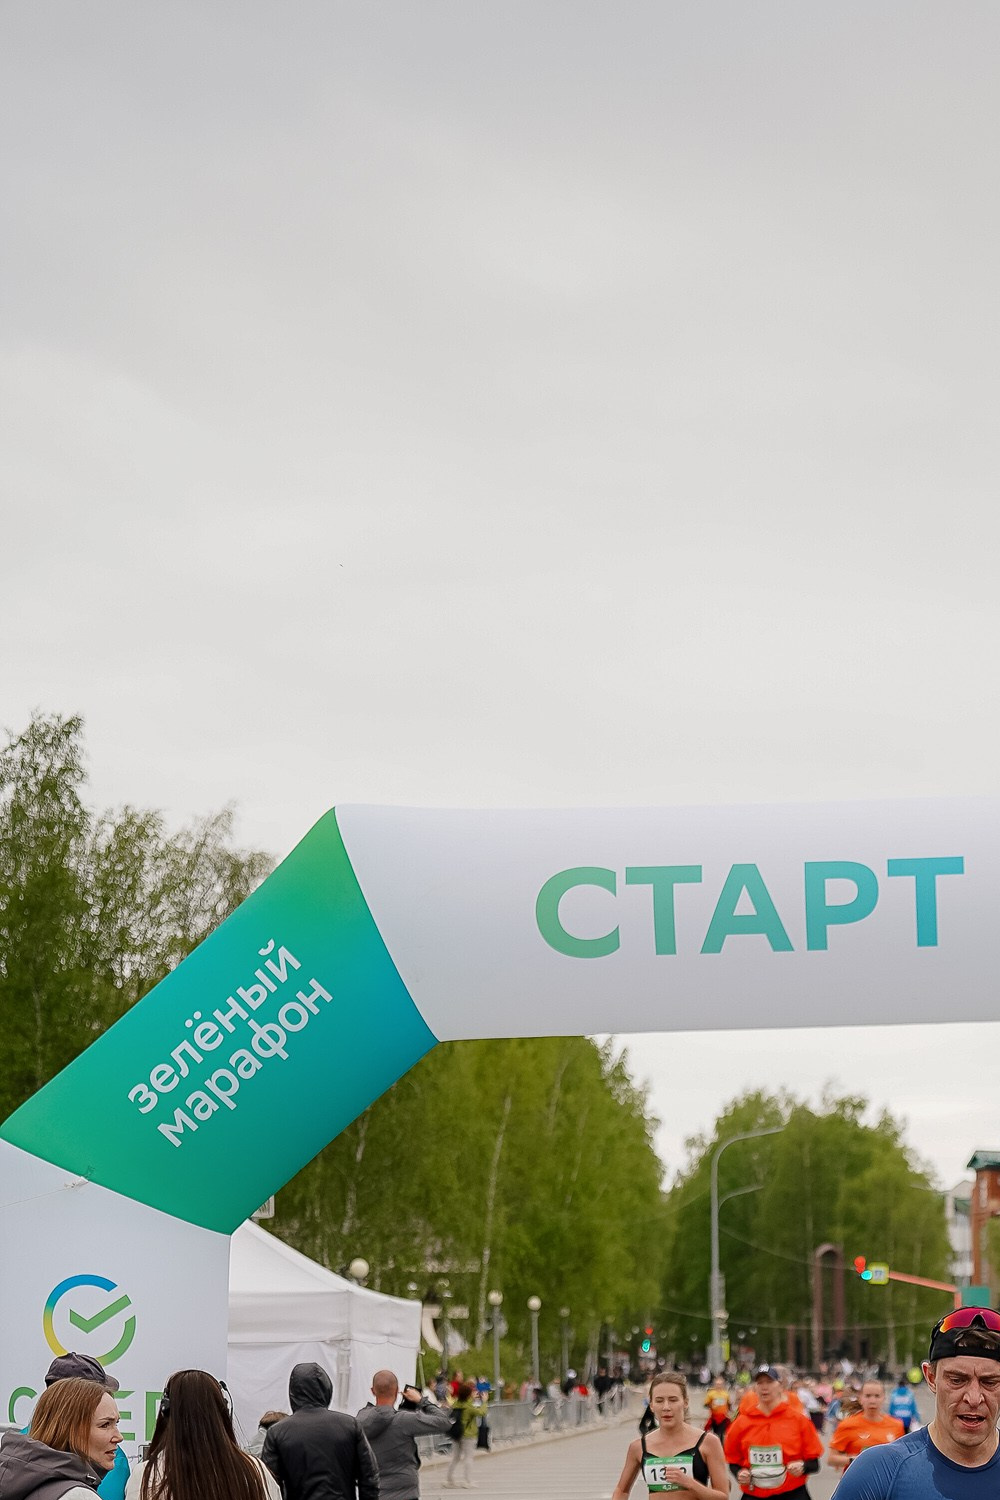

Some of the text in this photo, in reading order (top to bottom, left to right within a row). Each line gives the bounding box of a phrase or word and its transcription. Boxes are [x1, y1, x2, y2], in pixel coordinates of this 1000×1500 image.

[535, 856, 965, 959] СТАРТ
[127, 938, 302, 1115] зелёный
[157, 977, 334, 1148] марафон
[753, 1452, 778, 1463] 1331
